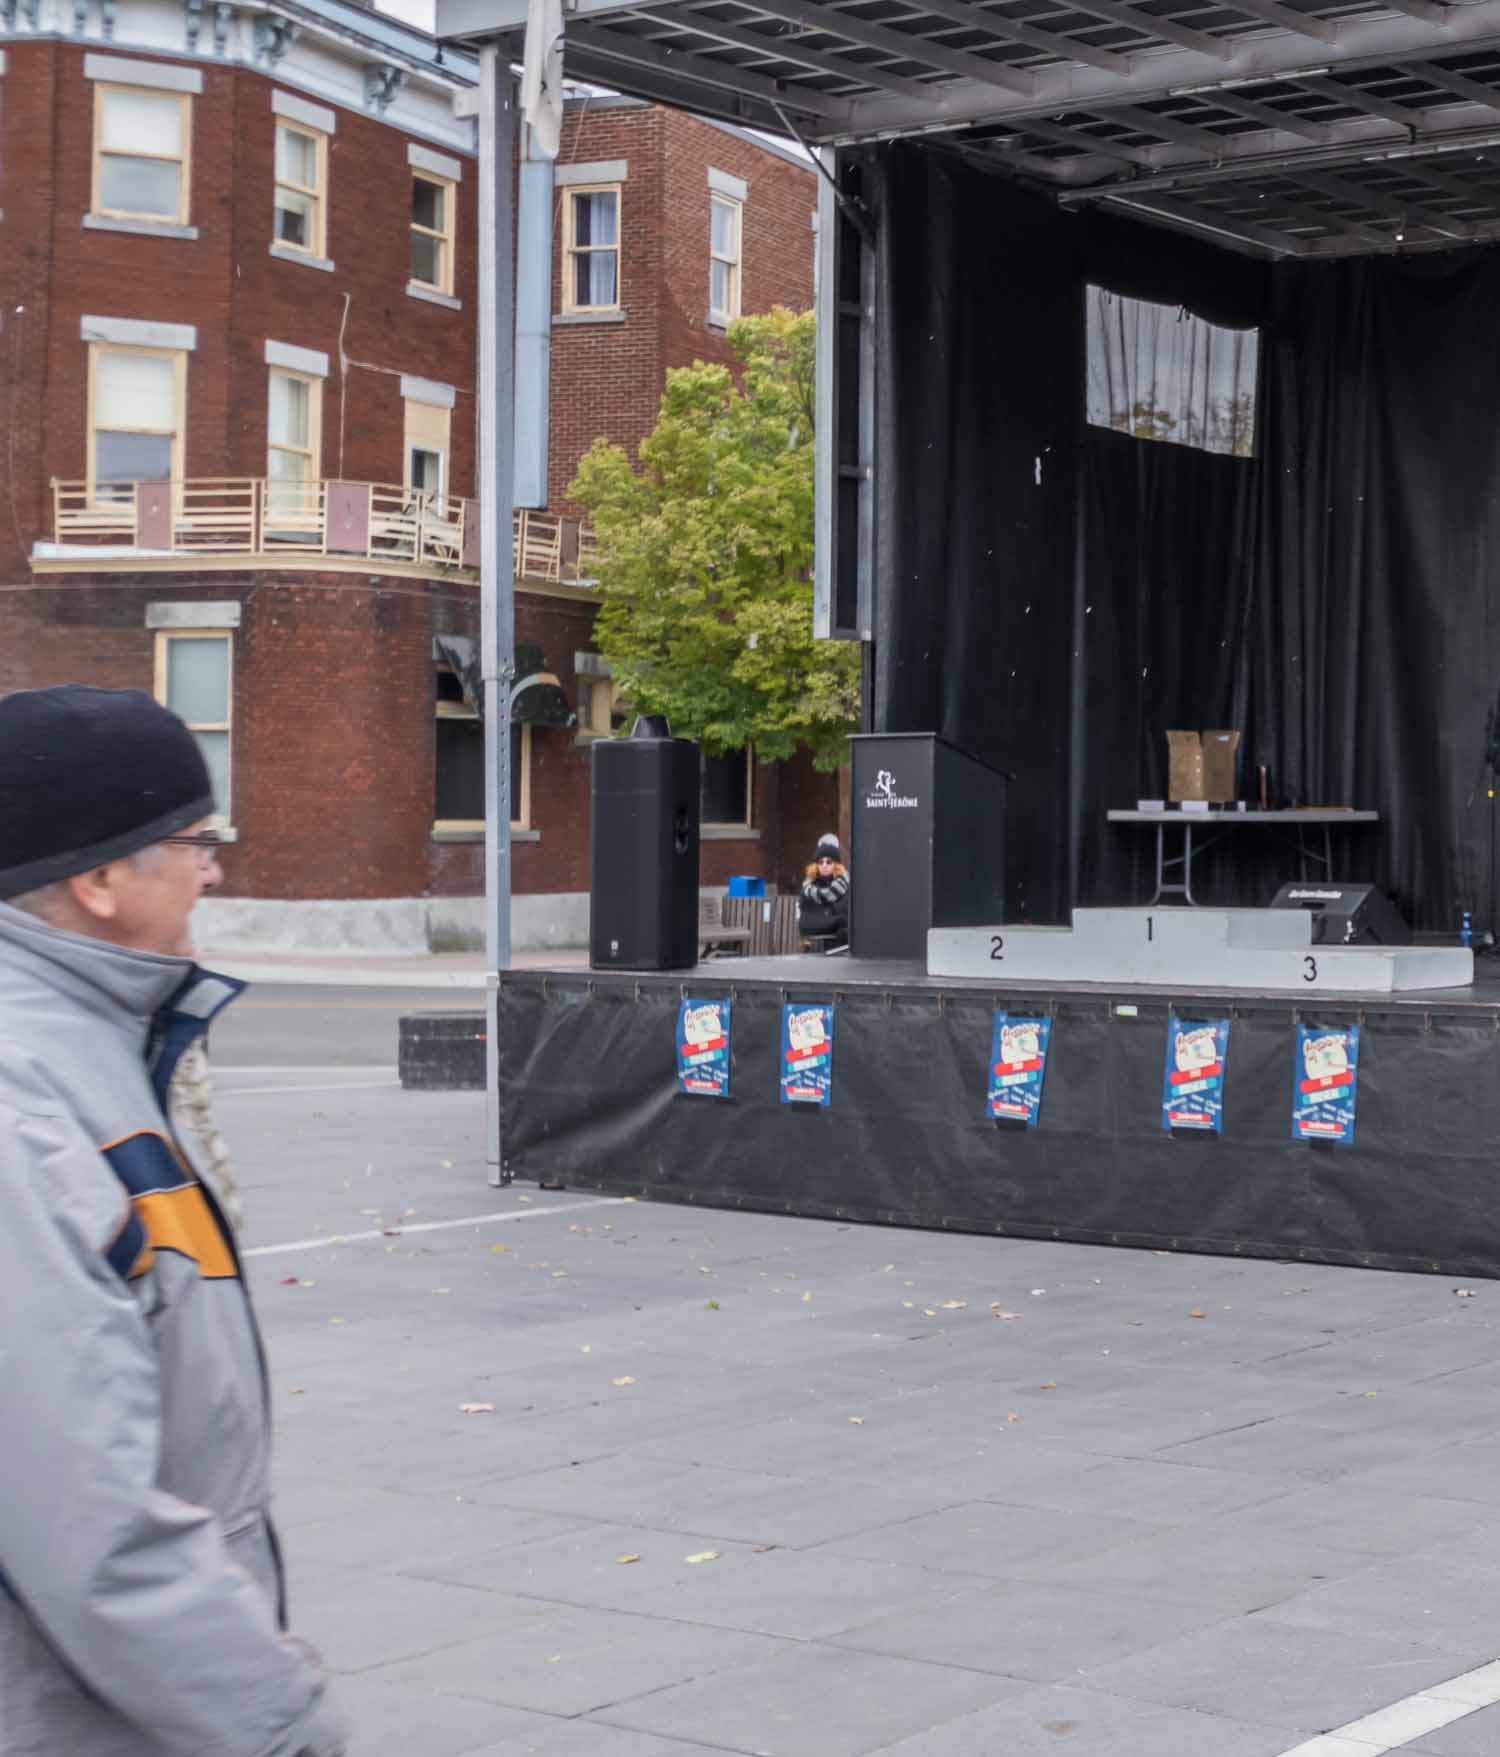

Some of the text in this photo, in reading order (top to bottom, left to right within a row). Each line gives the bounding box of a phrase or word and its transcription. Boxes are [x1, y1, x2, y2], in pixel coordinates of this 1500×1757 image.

[1145, 916, 1153, 942] 1
[990, 936, 1004, 960] 2
[1303, 956, 1317, 982] 3
